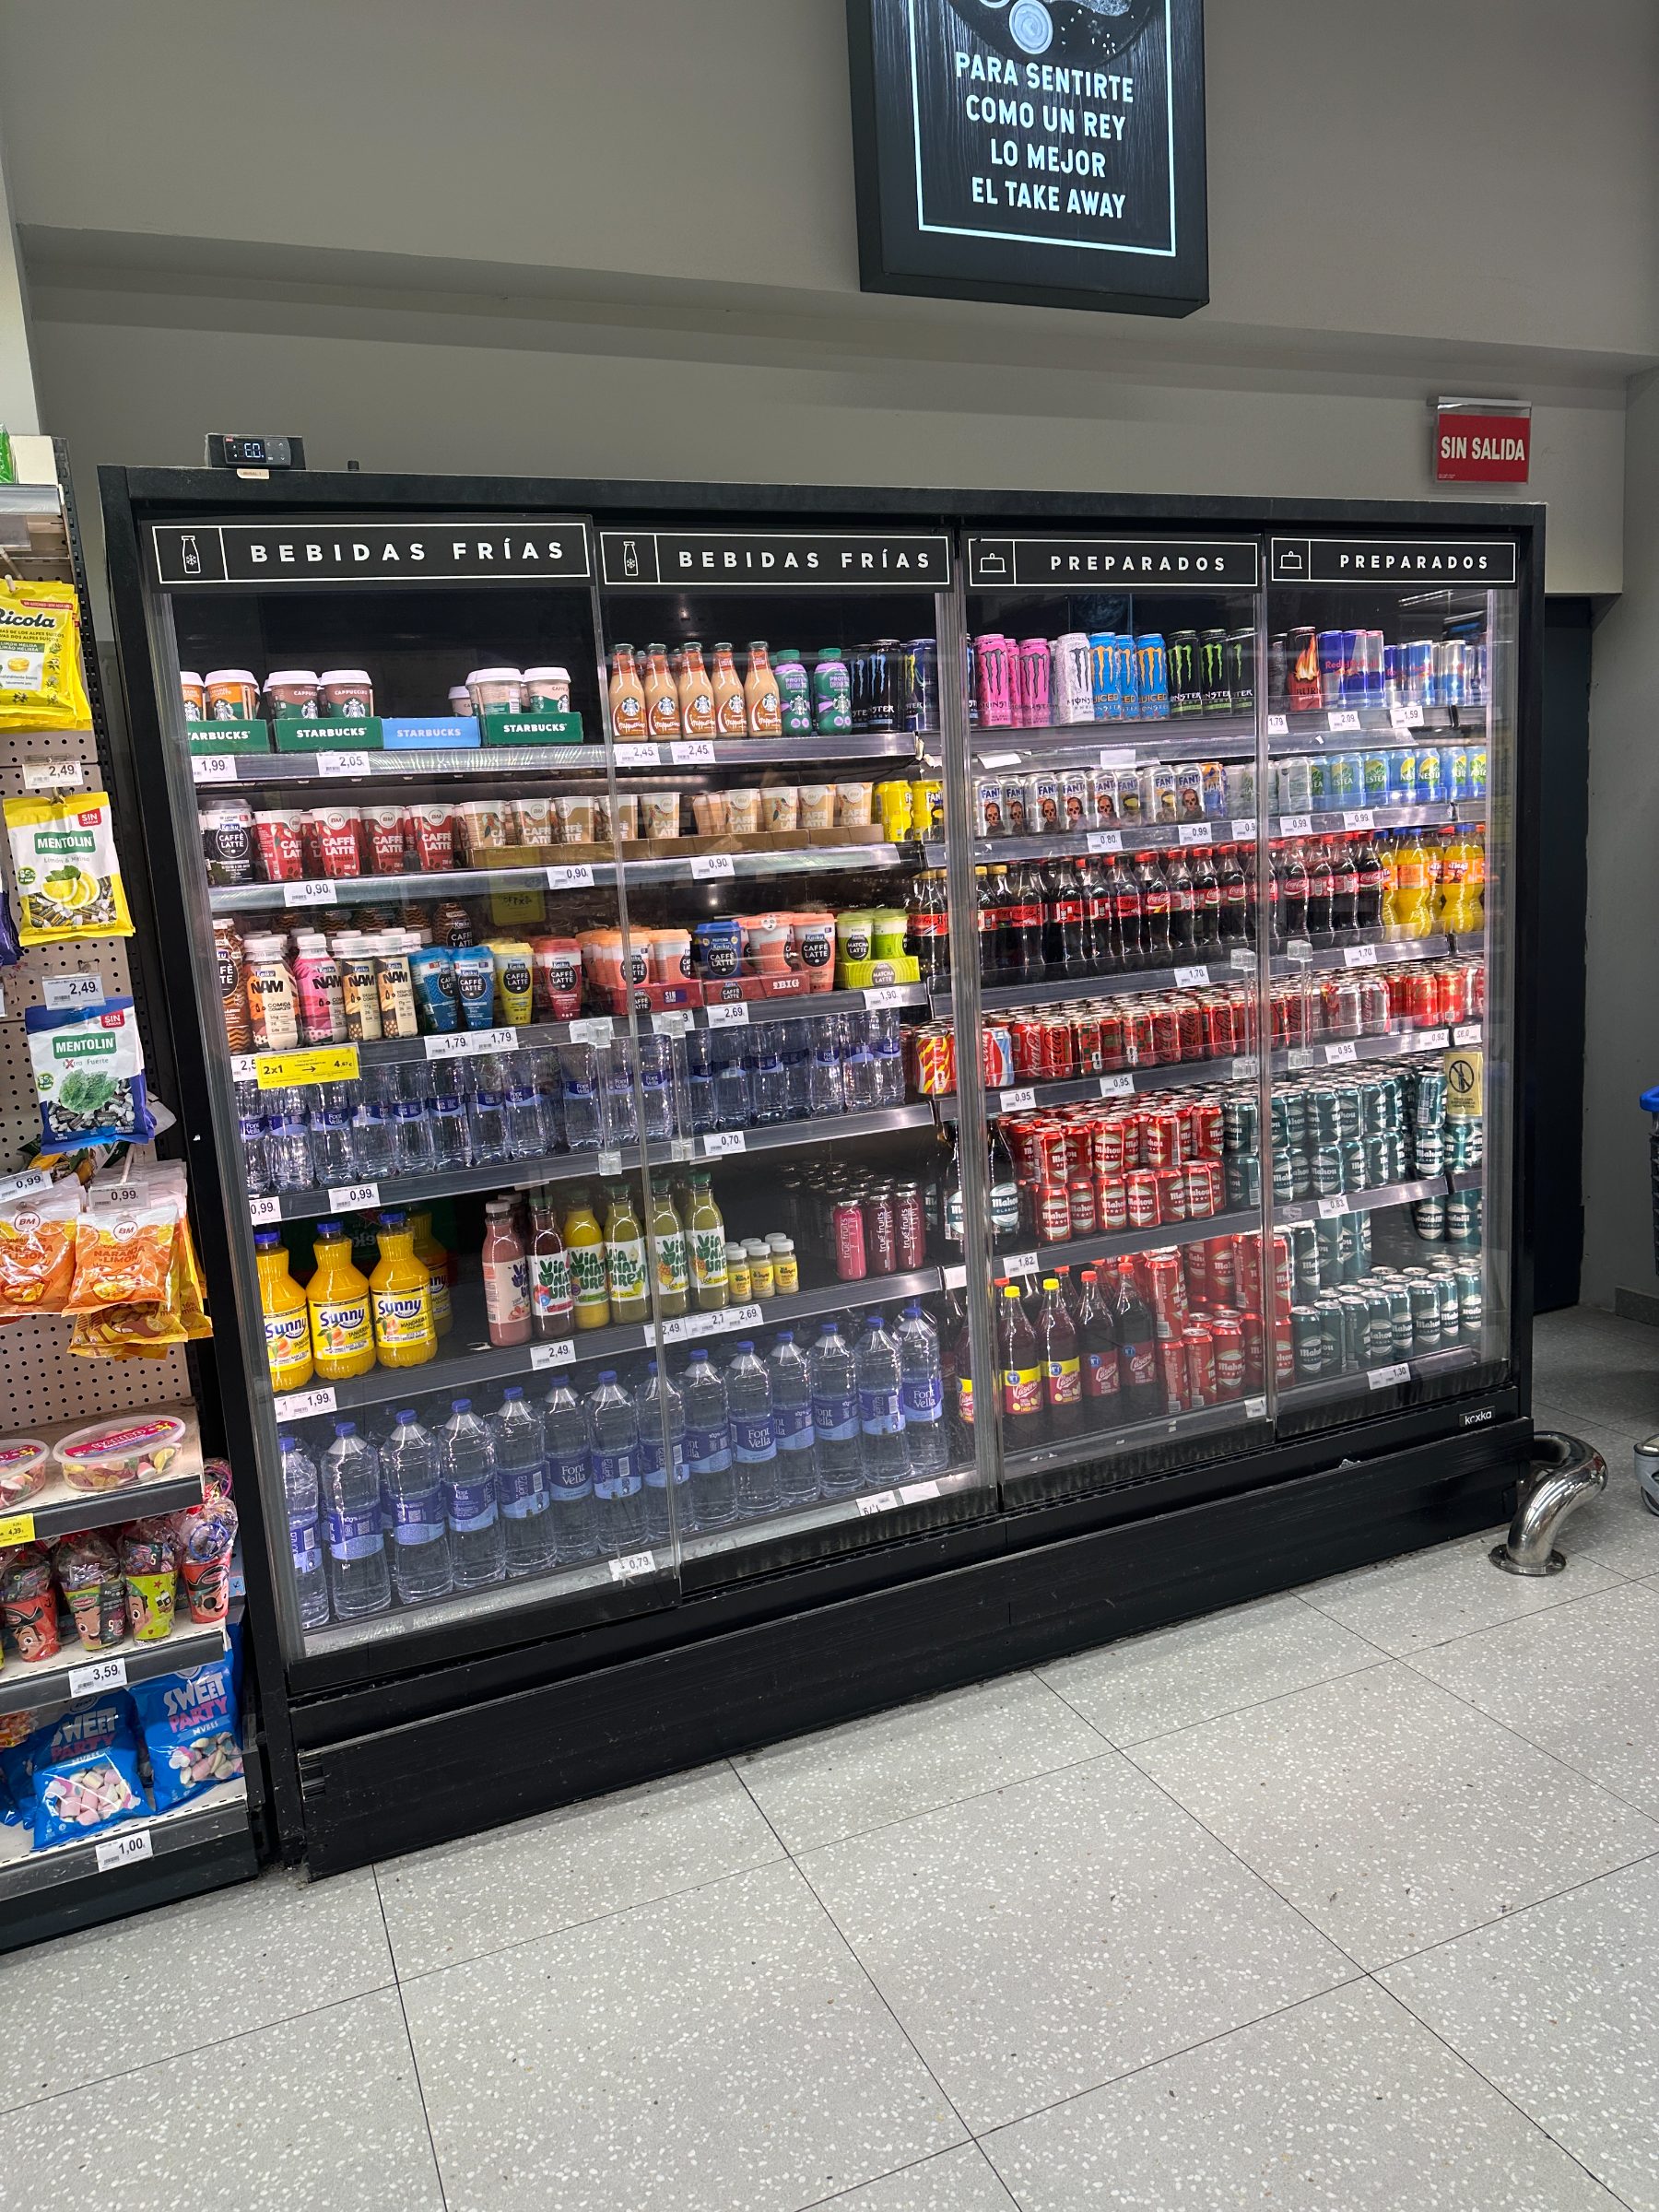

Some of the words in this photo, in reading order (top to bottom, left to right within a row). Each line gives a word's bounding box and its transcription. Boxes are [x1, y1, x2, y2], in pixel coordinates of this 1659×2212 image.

[955, 51, 1018, 87] PARA
[1026, 63, 1135, 104] SENTIRTE
[965, 94, 1035, 129] COMO
[1042, 106, 1076, 135] UN
[1083, 112, 1127, 141] REY
[990, 138, 1018, 167] LO
[1026, 143, 1107, 179] MEJOR
[971, 176, 998, 205] EL
[1004, 181, 1061, 212] TAKE
[1065, 190, 1127, 219] AWAY
[1441, 435, 1467, 460] SIN
[1471, 437, 1526, 461] SALIDA
[250, 542, 427, 563] BEBIDAS
[453, 536, 565, 561] FRÍAS
[677, 550, 821, 569] BEBIDAS
[841, 547, 931, 570] FRÍAS
[1050, 555, 1227, 572] PREPARADOS
[1339, 553, 1489, 571] PREPARADOS
[296, 726, 367, 738] STARBUCKS
[396, 727, 462, 737] STARBUCKS
[503, 723, 567, 733] STARBUCKS
[187, 730, 251, 741] TARBUCKS
[633, 747, 654, 757] 2,45
[688, 745, 708, 755] 2,45
[201, 759, 226, 772] 1,99
[338, 756, 362, 768] 2,05
[48, 764, 75, 779] 2,49
[1038, 784, 1057, 795] FANT
[81, 812, 98, 822] SIN
[37, 835, 93, 850] MENTOLIN
[218, 833, 244, 842] CAFFÈ
[221, 840, 244, 849] LATTE
[324, 844, 355, 854] LATTE
[375, 843, 404, 854] LATTE
[424, 841, 452, 851] LATTE
[566, 868, 587, 879] 0,90
[305, 883, 329, 895] 0,90
[805, 950, 829, 959] LATTE
[69, 981, 97, 997] 2,49
[104, 1014, 122, 1023] SIN
[724, 1006, 743, 1018] 2,69
[445, 1037, 466, 1049] 1,79
[491, 1031, 512, 1043] 1,79
[55, 1038, 114, 1053] MENTOLIN
[263, 1065, 284, 1076] 2x1
[16, 1175, 41, 1189] 0,99
[111, 1189, 136, 1201] 0,99
[349, 1188, 372, 1201] 0,99
[250, 1202, 274, 1215] 0,99
[18, 1218, 36, 1227] BM
[378, 1298, 422, 1316] Sunny
[319, 1307, 365, 1327] Sunny
[739, 1308, 758, 1320] 2,69
[548, 1347, 570, 1358] 2,49
[307, 1393, 329, 1407] 1,99
[1464, 1409, 1492, 1426] koxka
[747, 1427, 771, 1441] Font
[747, 1436, 772, 1450] Vella
[560, 1462, 585, 1477] Font
[561, 1472, 587, 1485] Vella
[629, 1555, 650, 1570] 0,79
[92, 1664, 119, 1681] 3,59
[163, 1672, 226, 1717] SWEET
[171, 1698, 229, 1734] PARTY
[51, 1706, 118, 1747] SWEET
[118, 1837, 144, 1855] 1,00
